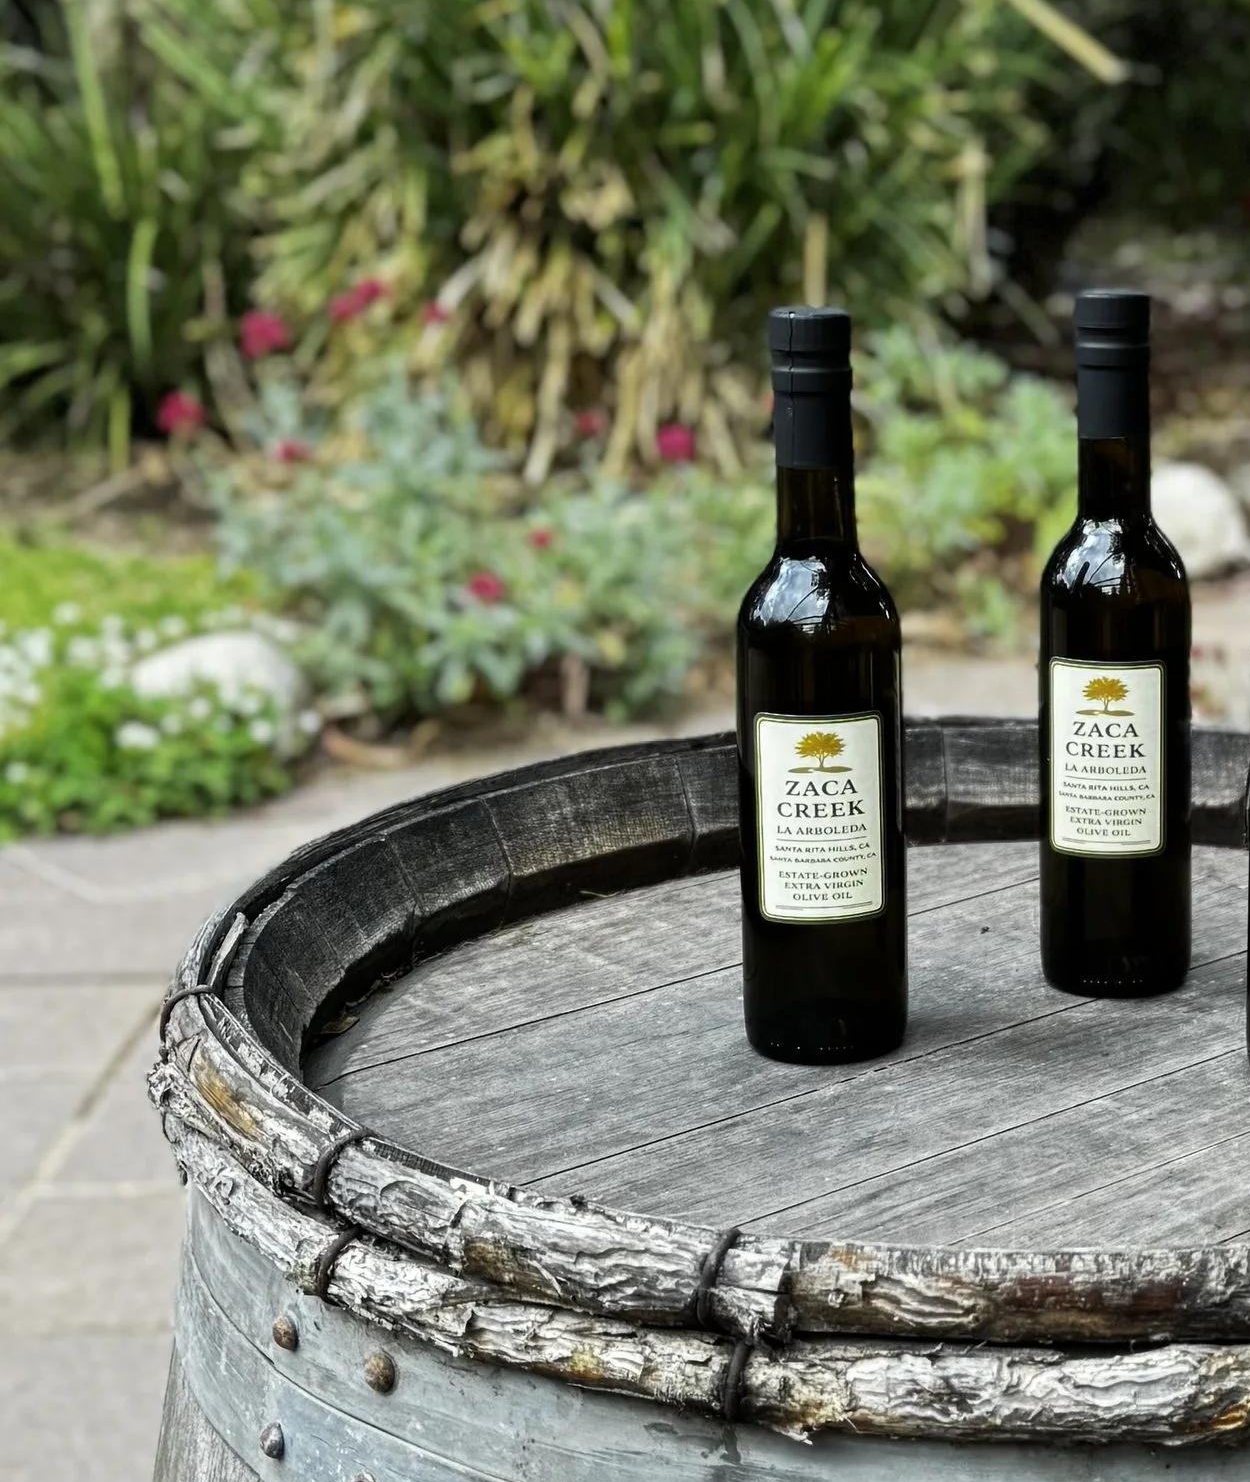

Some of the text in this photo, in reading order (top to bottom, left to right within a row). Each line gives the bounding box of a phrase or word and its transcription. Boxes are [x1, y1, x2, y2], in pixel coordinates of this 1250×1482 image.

[1073, 721, 1139, 738] ZACA
[1066, 741, 1146, 758] CREEK
[1065, 763, 1146, 775] LA ARBOLEDA
[785, 779, 858, 796] ZACA
[1063, 781, 1086, 790] SANTA
[777, 799, 865, 818] CREEK
[1065, 806, 1146, 816] ESTATE-GROWN
[1070, 817, 1102, 825] EXTRA
[777, 823, 867, 835] LA ARBOLEDA
[1077, 827, 1108, 836] OLIVE
[775, 845, 802, 853] SANTA
[805, 845, 826, 853] RITA
[770, 855, 792, 863] SANTA
[779, 867, 868, 879] ESTATE-GROWN
[784, 879, 864, 890] EXTRA VIRGIN
[792, 893, 828, 901] OLIVE
